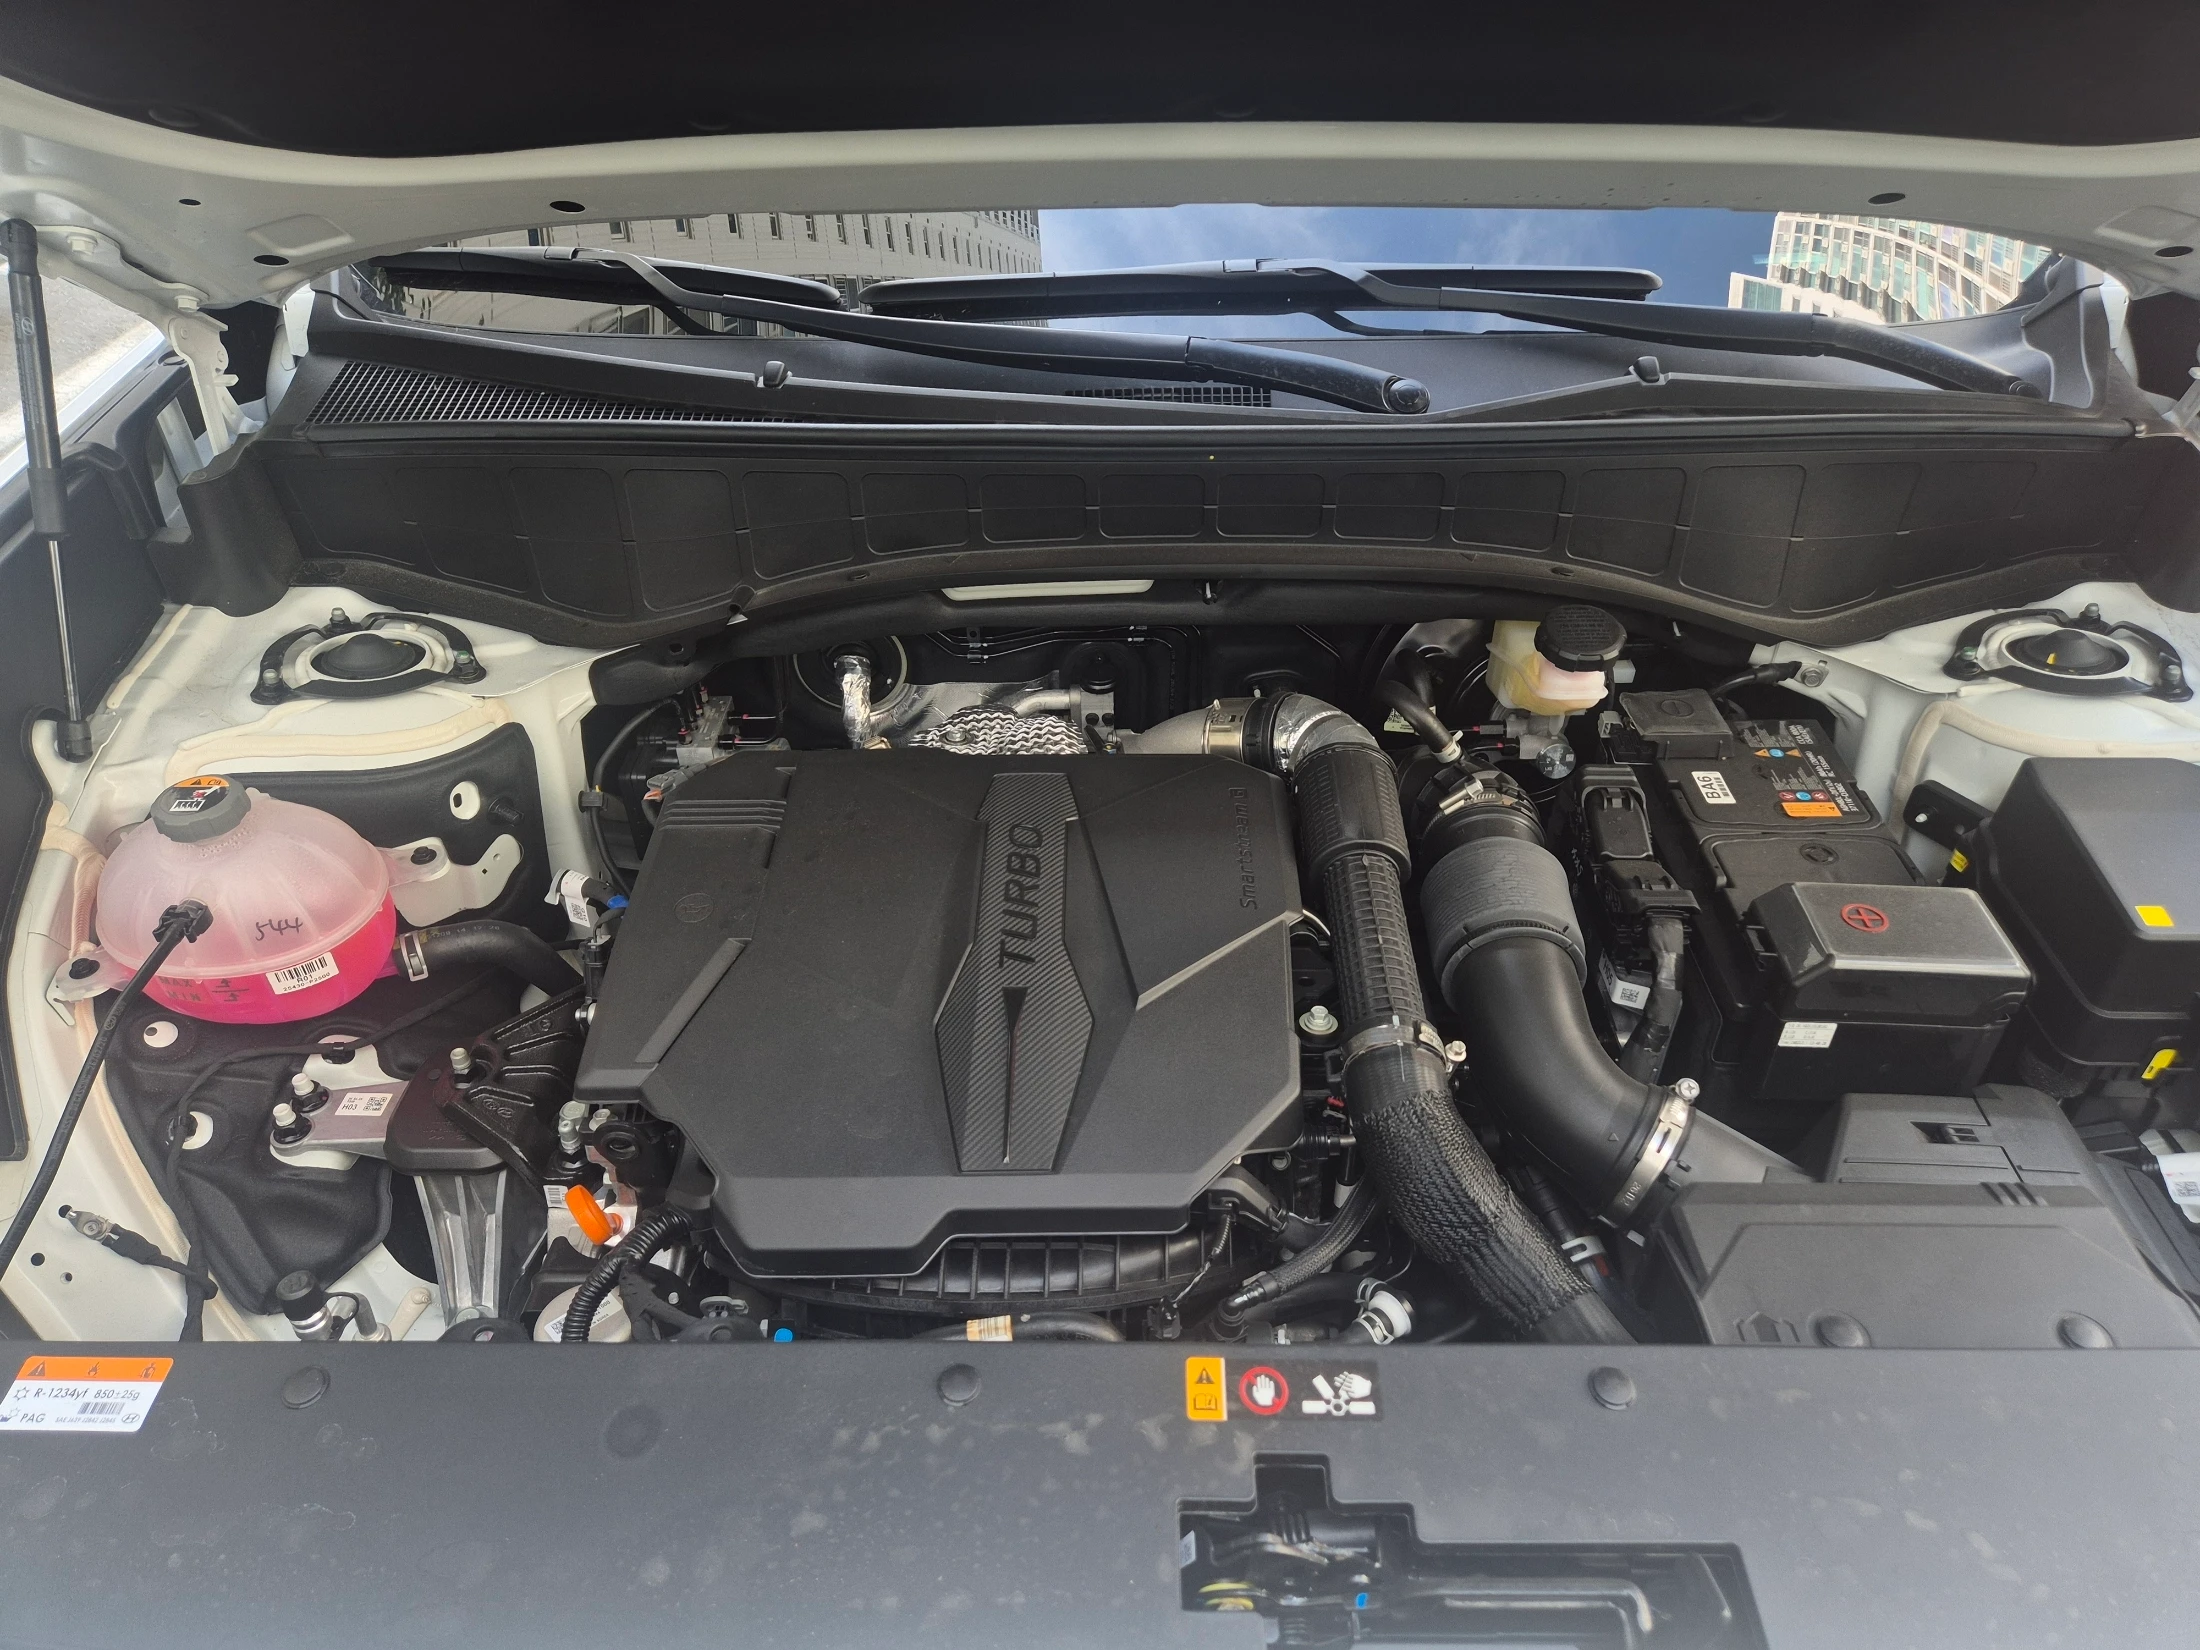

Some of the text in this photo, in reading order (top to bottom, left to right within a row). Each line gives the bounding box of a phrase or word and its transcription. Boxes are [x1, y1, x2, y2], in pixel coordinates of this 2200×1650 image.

[1697, 776, 1722, 799] BA6
[1232, 802, 1258, 910] Smartstream
[998, 823, 1044, 968] TURBO
[255, 916, 303, 941] 544
[297, 974, 313, 983] R01
[34, 1387, 141, 1401] R-1234yf 850±25g
[20, 1413, 46, 1423] PAG
